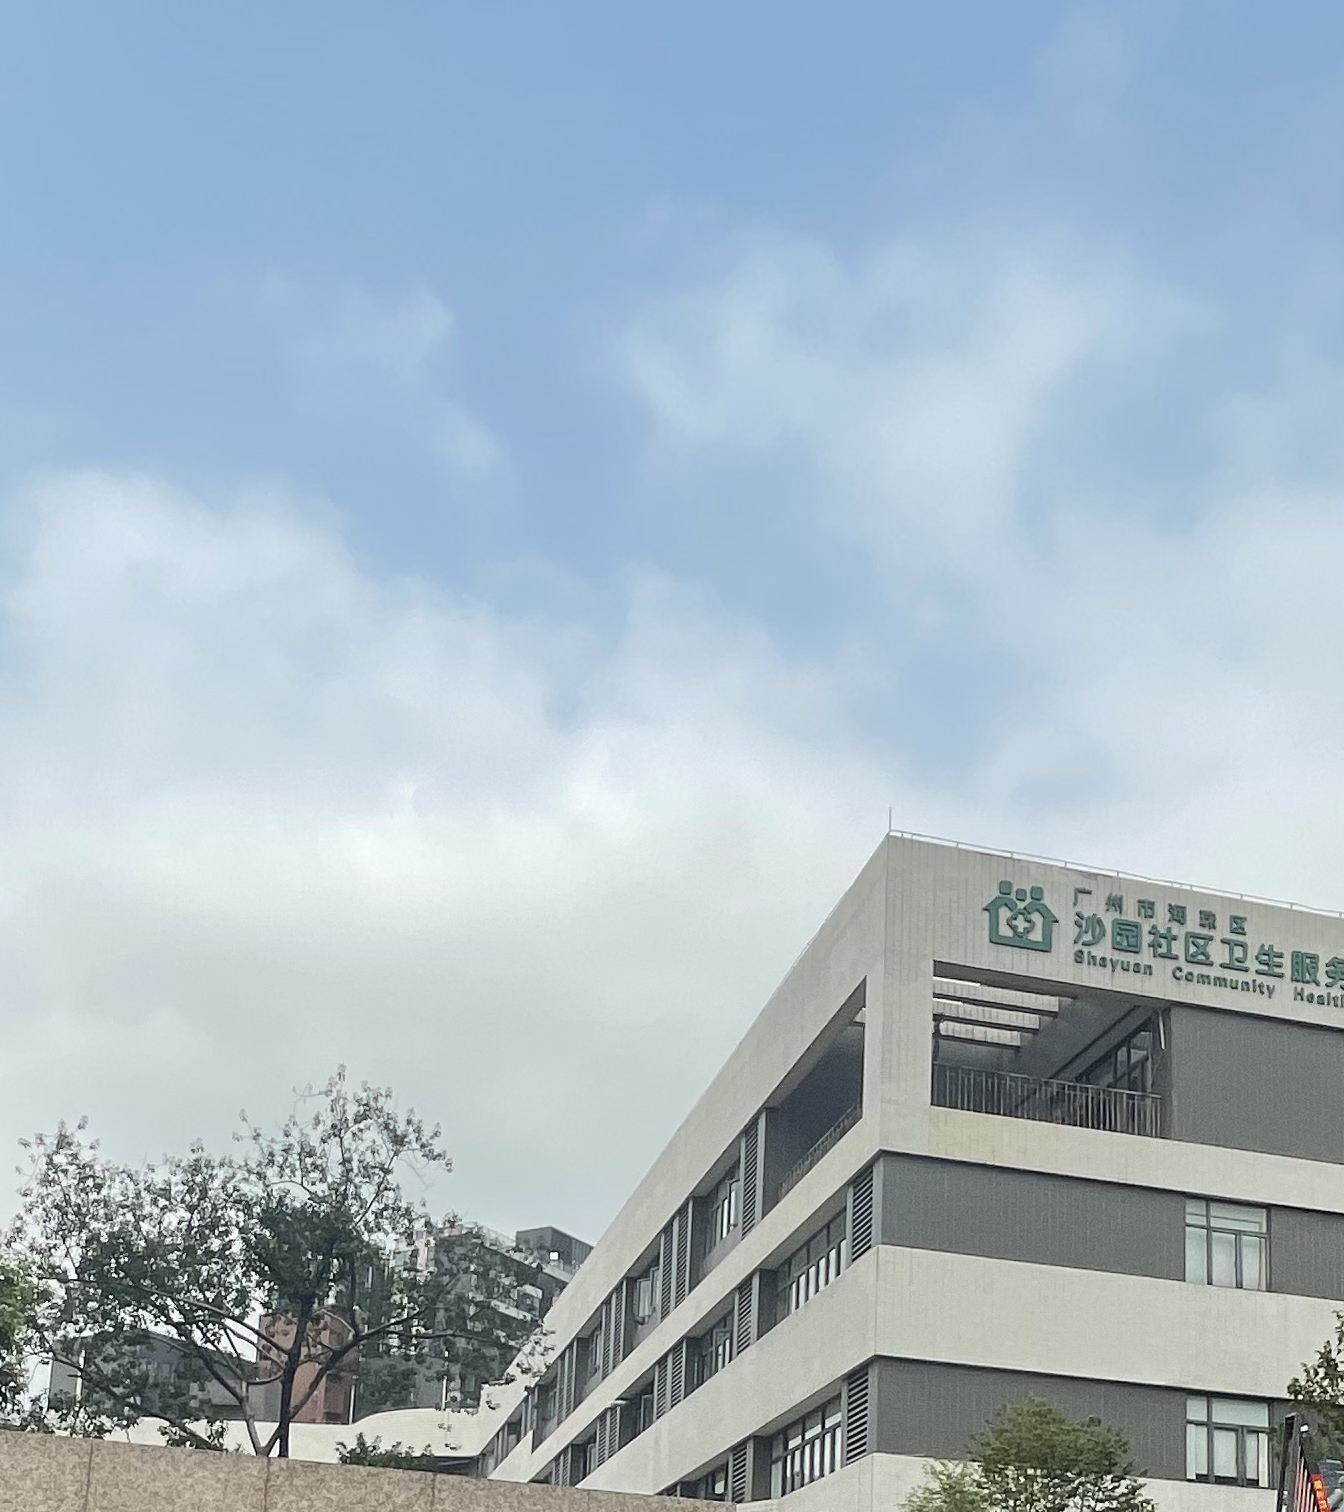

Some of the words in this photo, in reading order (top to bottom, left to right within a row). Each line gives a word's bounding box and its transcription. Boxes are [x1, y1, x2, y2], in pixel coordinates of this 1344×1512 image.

[1073, 887, 1249, 936] 广州市海珠区
[1074, 949, 1154, 977] Shayuan
[1171, 966, 1277, 999] Community
